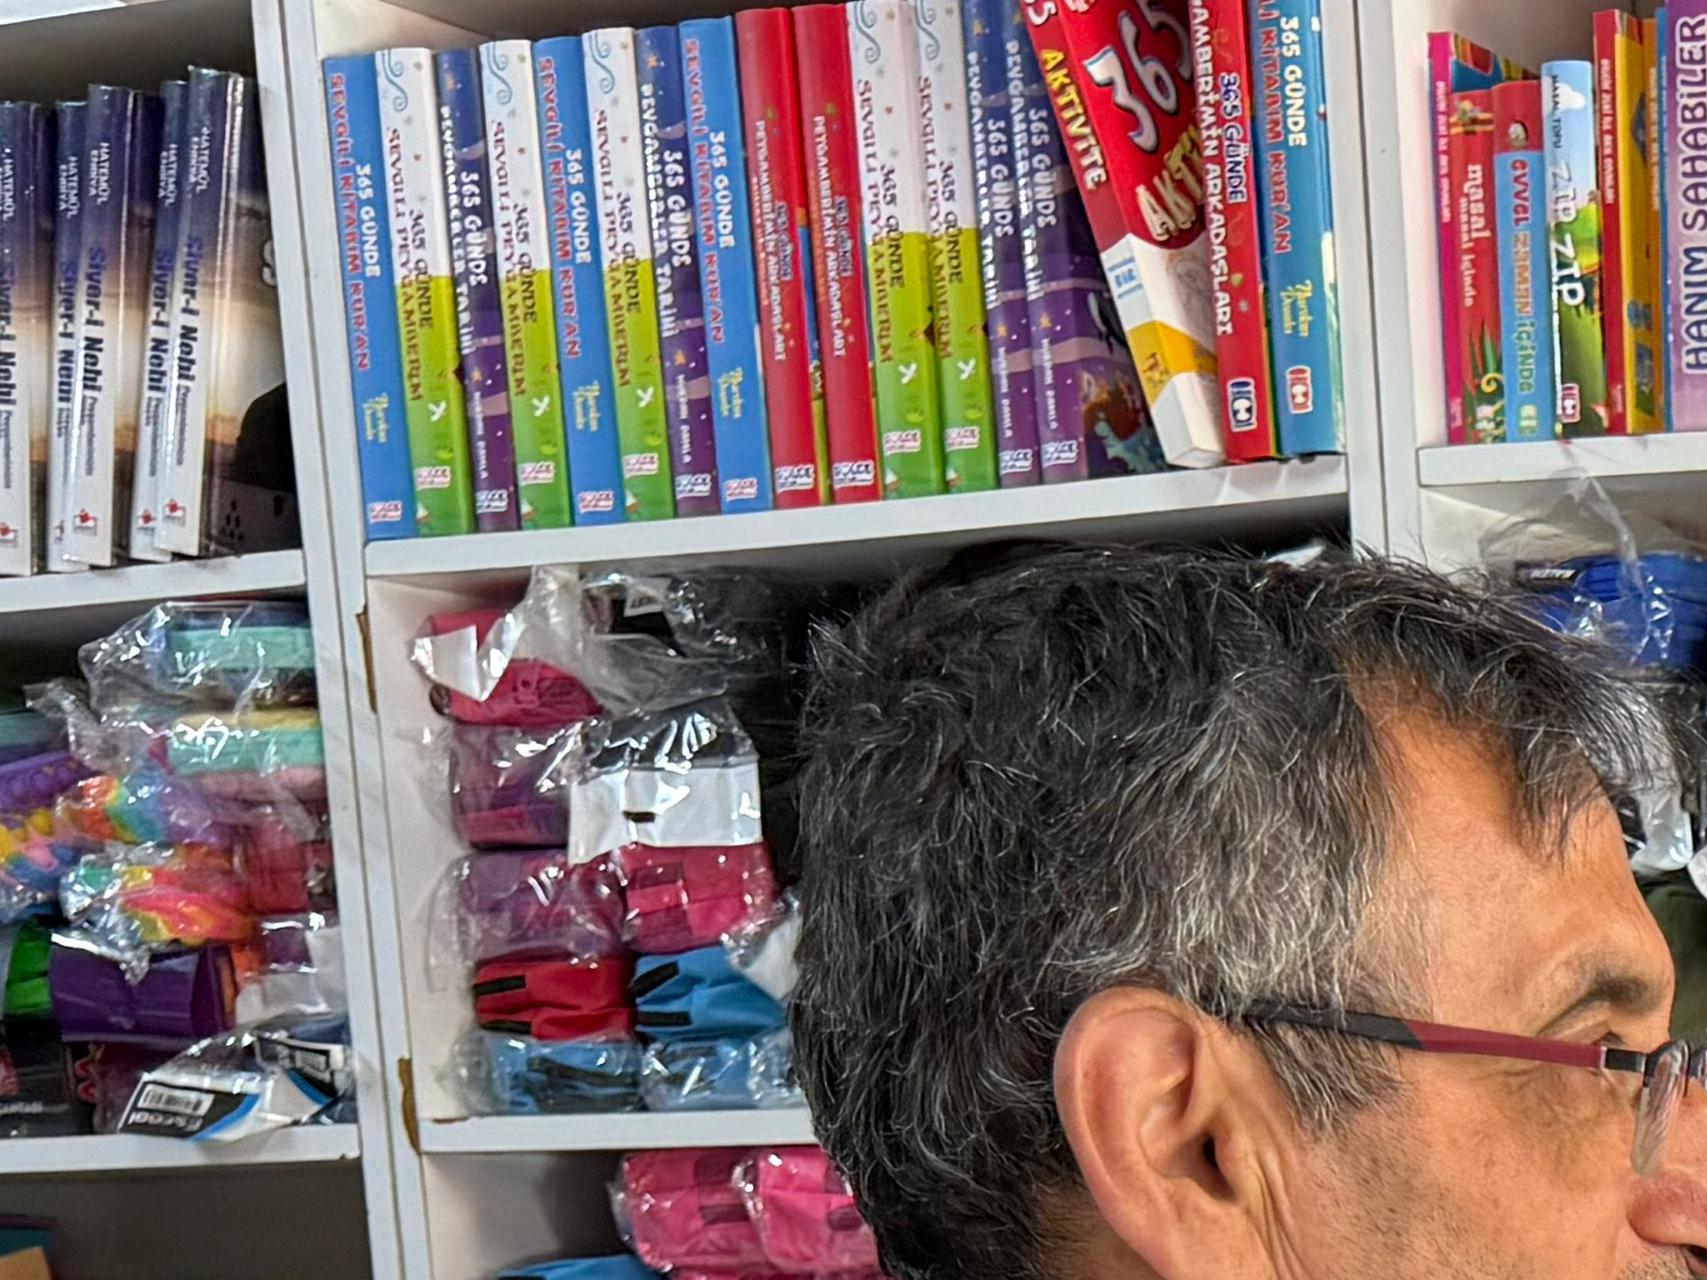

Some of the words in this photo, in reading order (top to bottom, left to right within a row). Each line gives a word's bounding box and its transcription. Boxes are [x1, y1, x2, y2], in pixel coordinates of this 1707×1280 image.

[1281, 16, 1301, 66] 365
[1219, 72, 1242, 119] 365
[1284, 66, 1309, 148] GÜNDE
[708, 131, 730, 169] 365
[986, 119, 1007, 157] 365
[1029, 108, 1050, 147] 365
[354, 162, 372, 203] 365
[564, 148, 585, 184] 365
[663, 149, 685, 190] 365
[879, 162, 900, 206] 365
[937, 157, 958, 201] 365
[1224, 122, 1249, 205] GÜNDE
[459, 171, 480, 211] 365
[615, 191, 635, 236] 365
[713, 173, 736, 250] GÜNDE
[775, 200, 790, 227] 365
[834, 195, 850, 222] 365
[990, 164, 1014, 238] GÜNDE
[1033, 154, 1057, 229] GÜNDE
[1464, 163, 1492, 240] masal
[361, 207, 382, 279] GÜNDE
[407, 208, 427, 251] 365
[511, 202, 532, 246] 365
[570, 189, 594, 265] GÜNDE
[668, 194, 693, 268] GÜNDE
[940, 208, 965, 284] GÜNDE
[1204, 162, 1234, 337] ARKADAŞLARI
[464, 214, 489, 287] GÜNDE
[777, 231, 794, 281] GÜNDE
[838, 226, 856, 278] GÜNDE
[882, 213, 906, 290] GÜNDE
[411, 256, 434, 329] GÜNDE
[514, 251, 538, 325] GÜNDE
[618, 242, 643, 315] GÜNDE
